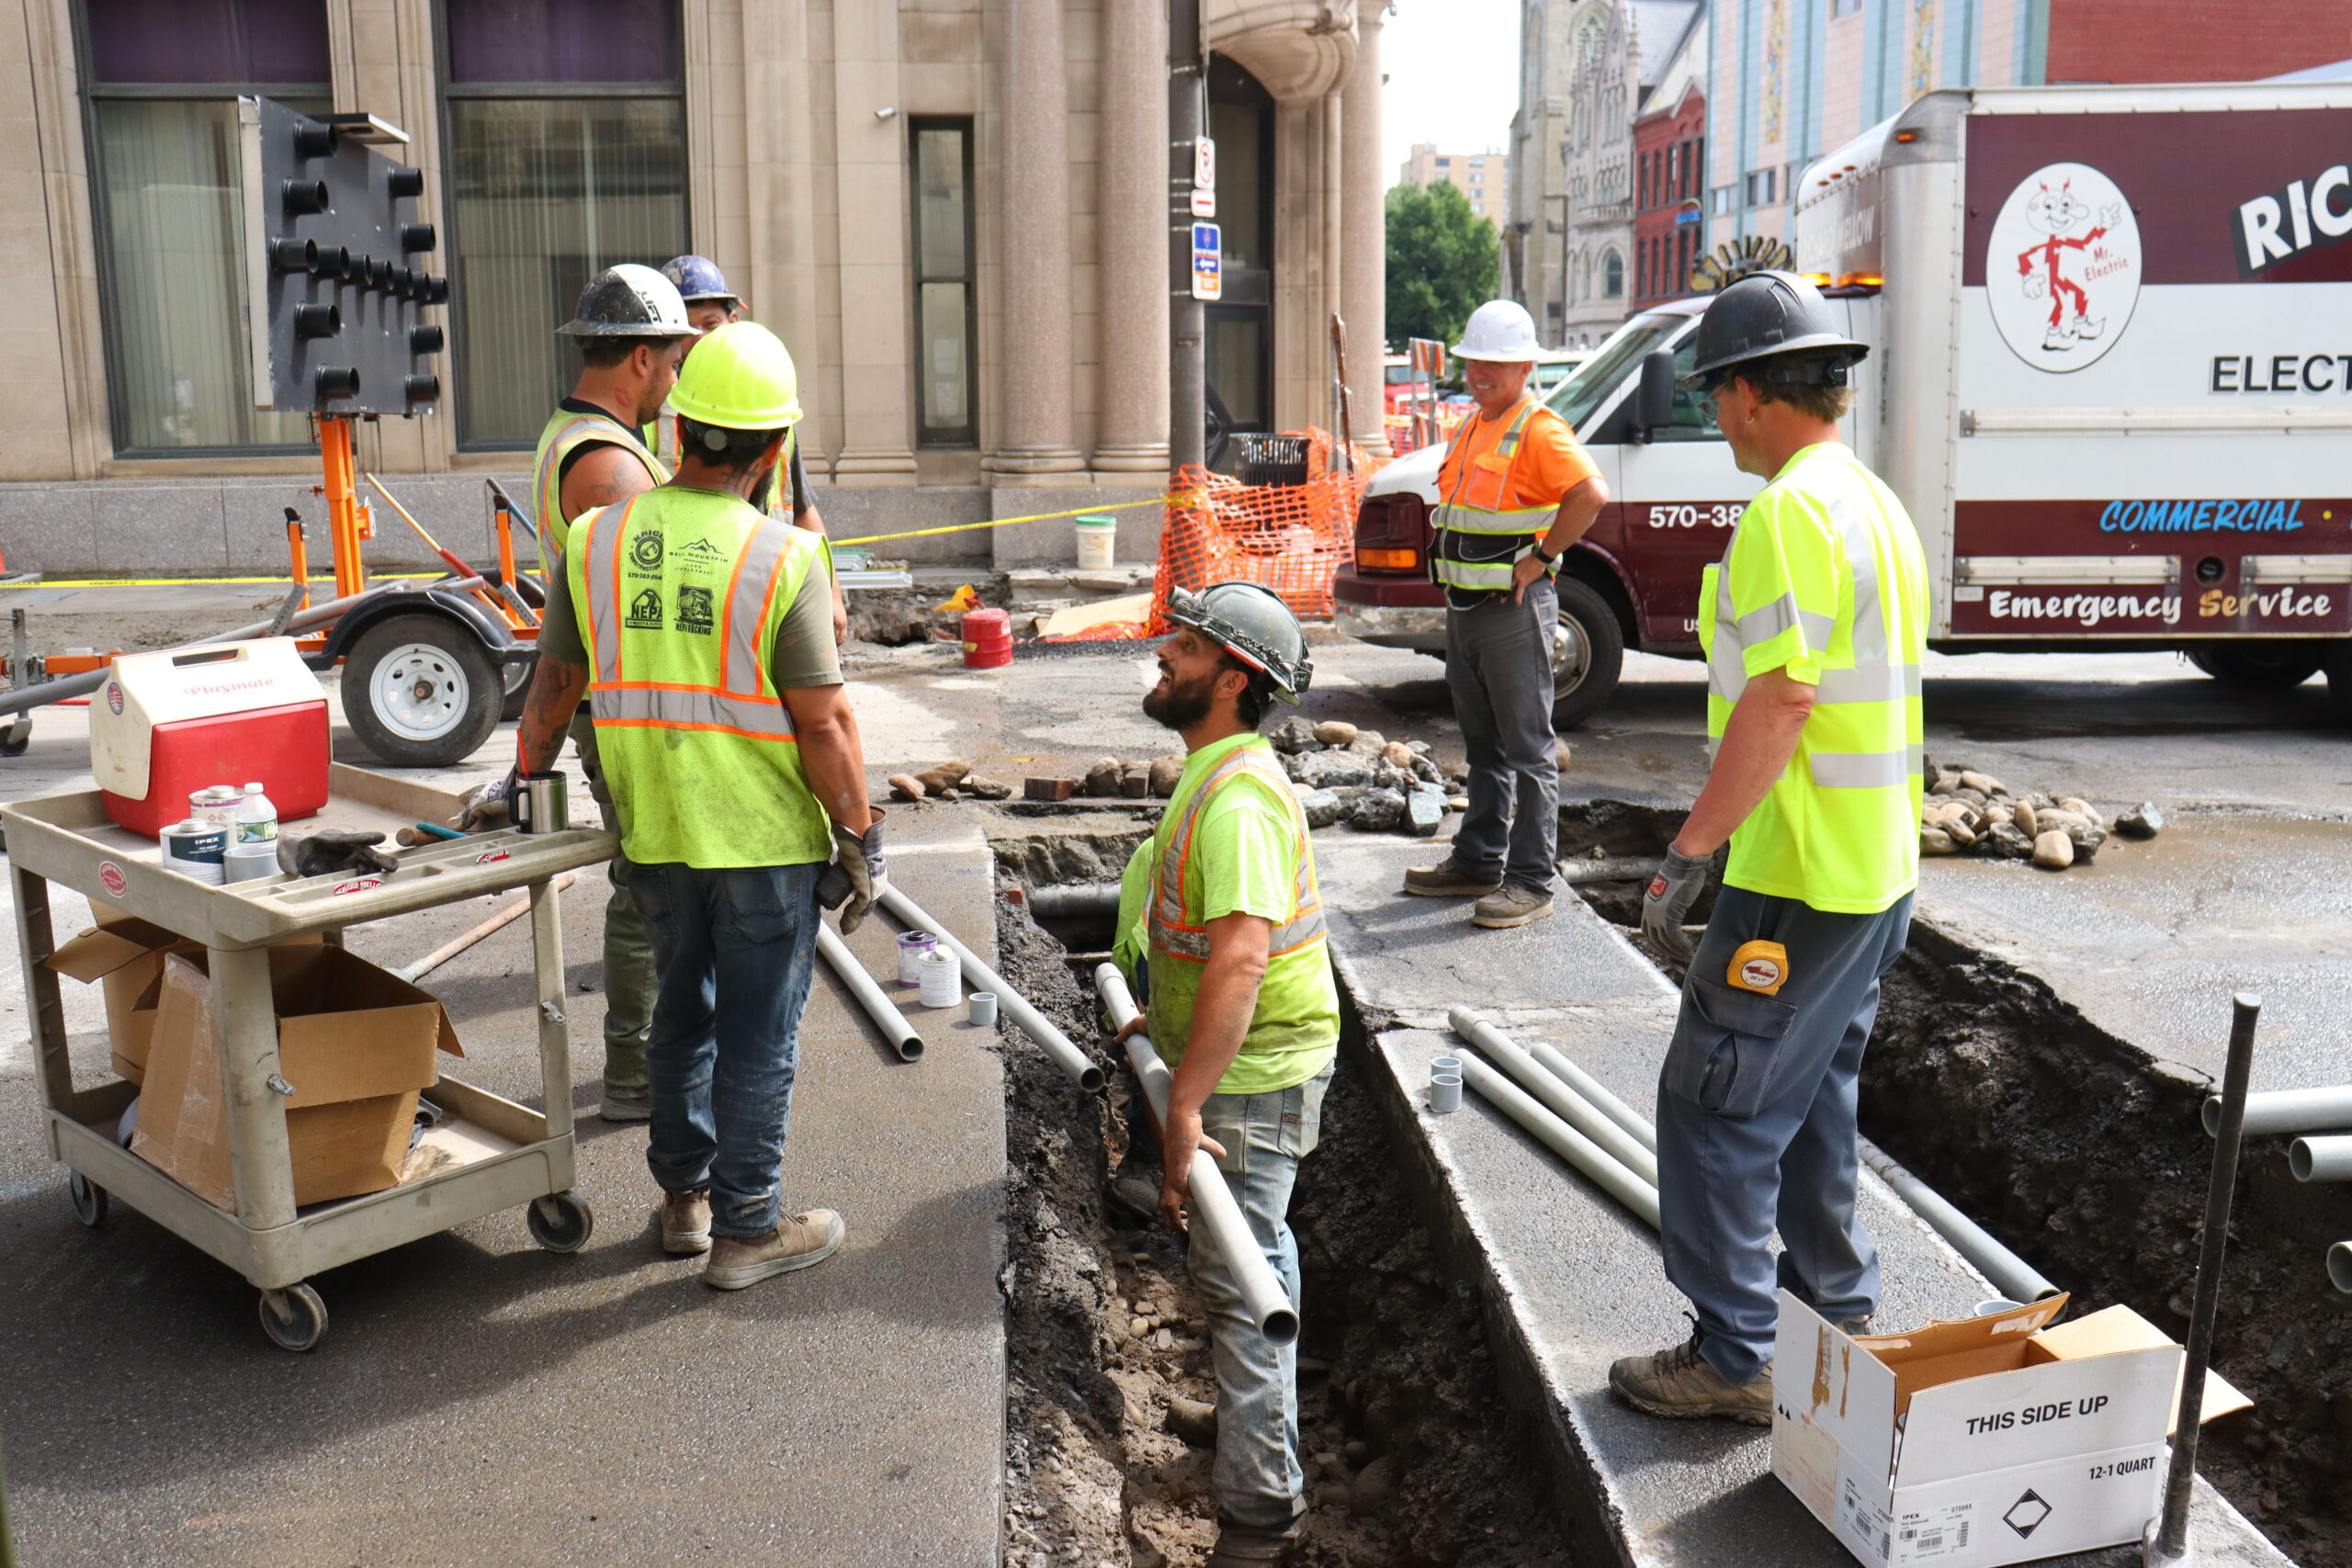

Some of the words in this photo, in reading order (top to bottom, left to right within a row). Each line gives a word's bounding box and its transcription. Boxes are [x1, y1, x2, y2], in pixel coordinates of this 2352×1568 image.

[2239, 164, 2352, 270] RIC
[2094, 246, 2113, 263] Mr.
[2085, 257, 2129, 282] Electric
[2099, 499, 2304, 532] COMMERCIAL
[687, 552, 729, 562] MOUNTAIN
[1989, 590, 2182, 626] Emergency
[2199, 586, 2332, 617] Service
[184, 678, 275, 695] Playmate
[194, 837, 220, 845] IPEX
[1966, 1412, 2015, 1436] THIS
[2021, 1401, 2073, 1425] SIDE
[2078, 1395, 2109, 1416] UP
[2089, 1466, 2114, 1480] 12-1
[2116, 1457, 2156, 1475] QUART
